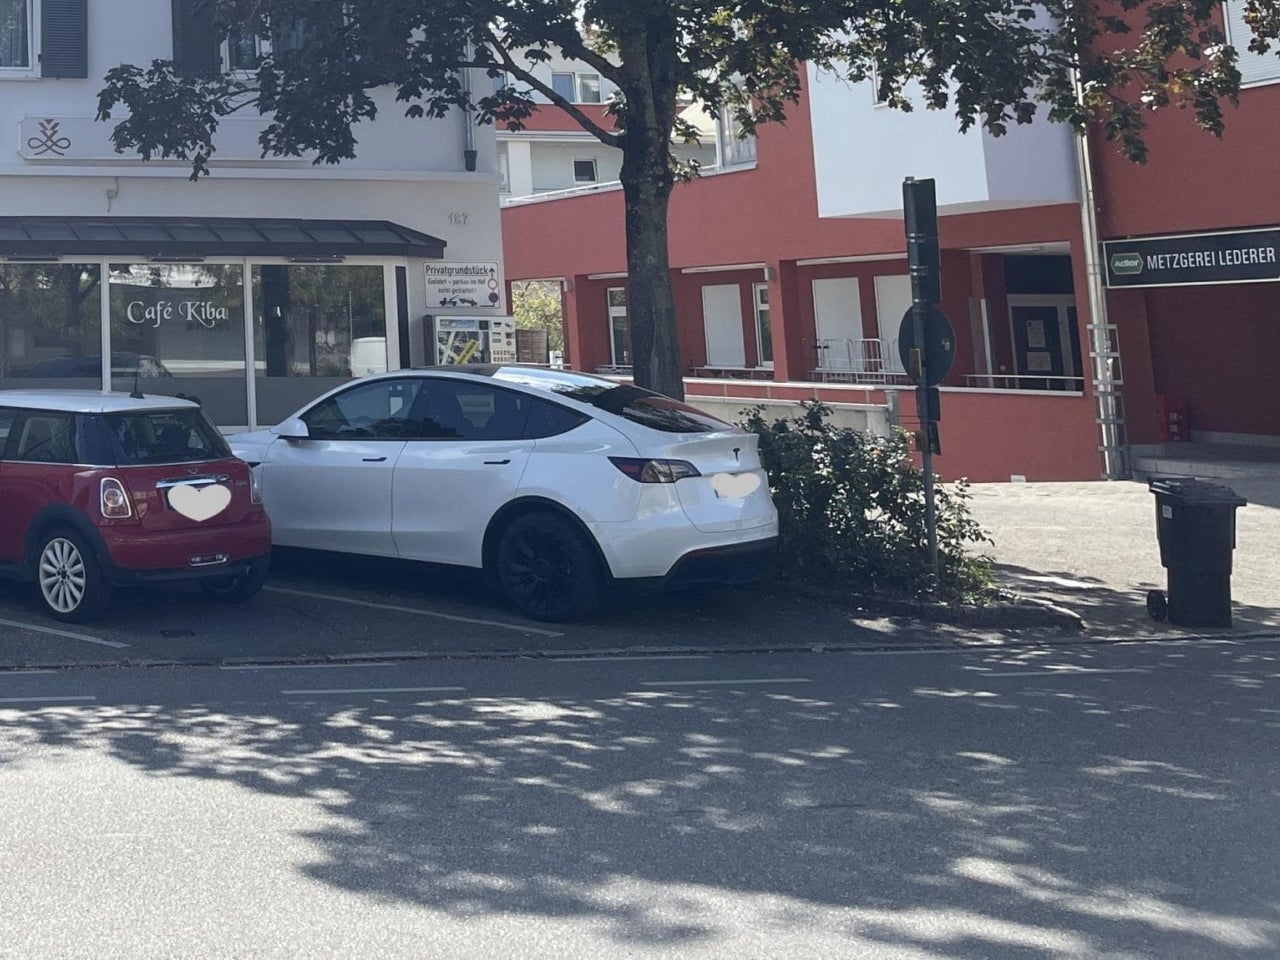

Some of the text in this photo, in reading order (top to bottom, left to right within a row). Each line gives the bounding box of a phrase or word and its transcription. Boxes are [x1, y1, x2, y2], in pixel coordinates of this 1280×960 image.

[1147, 247, 1276, 270] METZGEREI LEDERER
[425, 265, 488, 276] Privatgrundstück
[127, 301, 226, 328] Café Kiba
